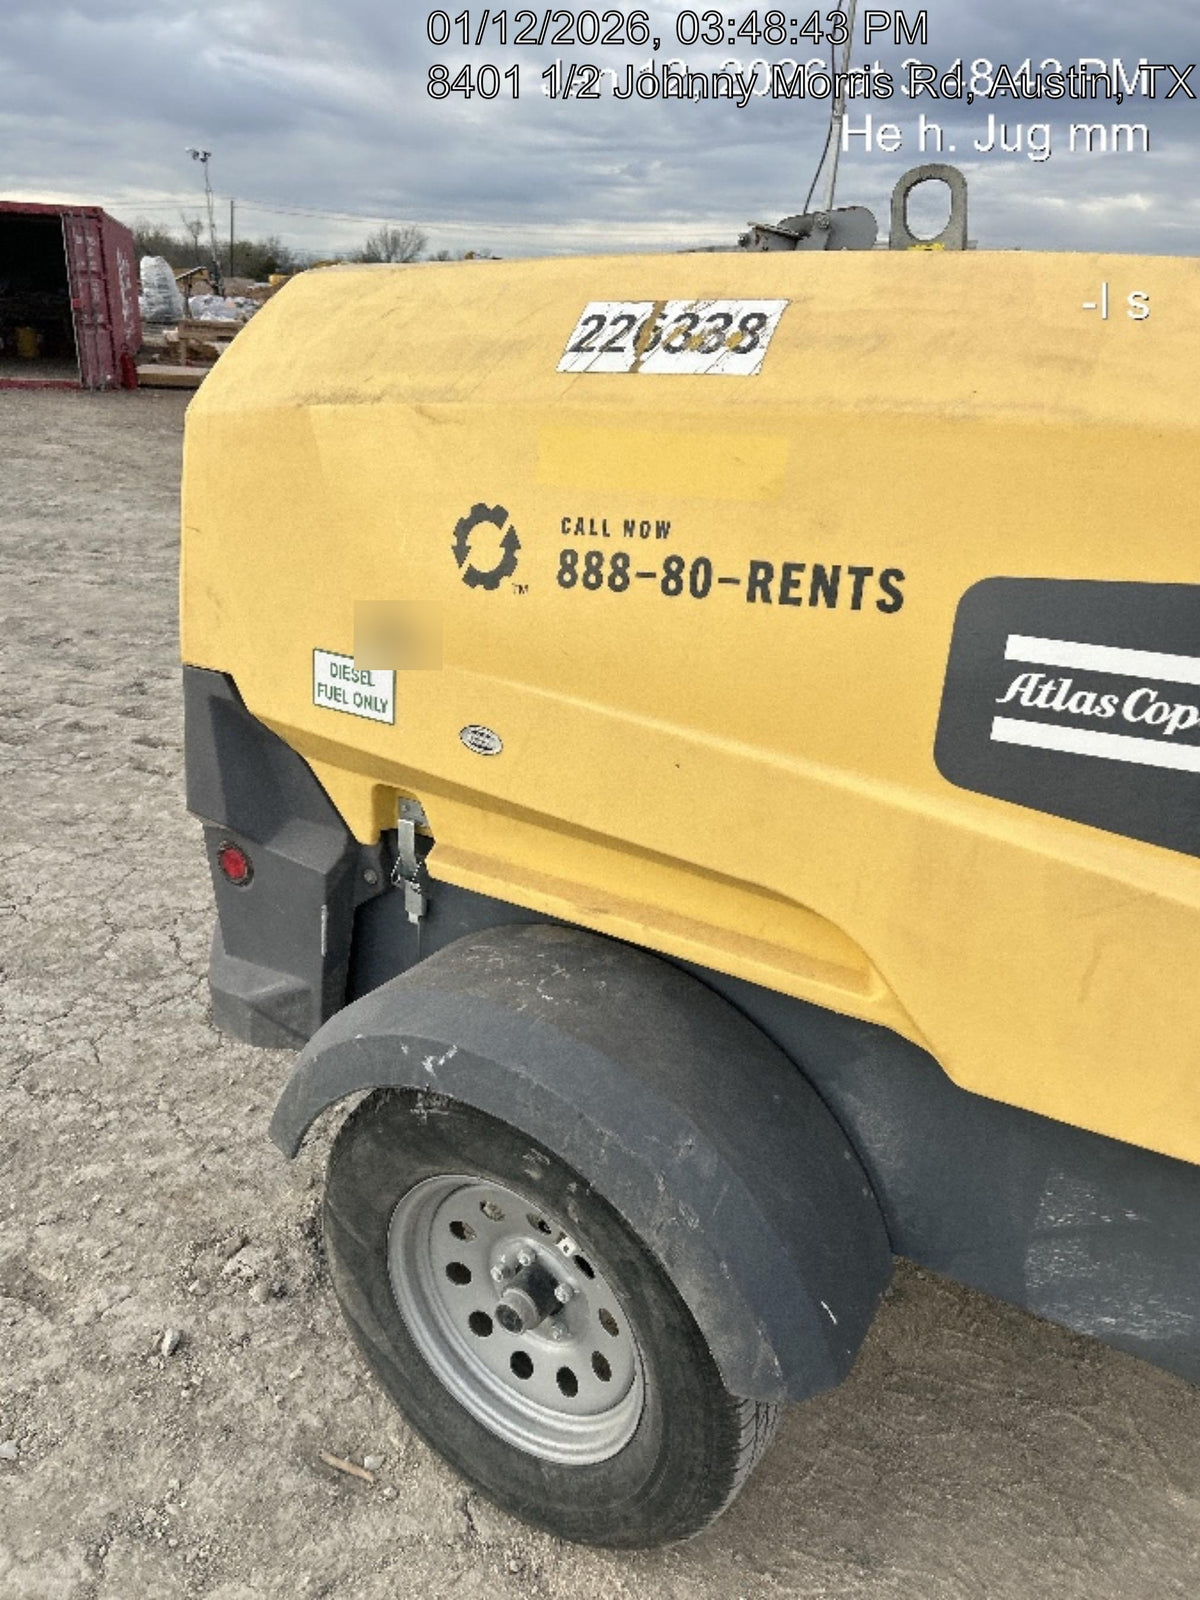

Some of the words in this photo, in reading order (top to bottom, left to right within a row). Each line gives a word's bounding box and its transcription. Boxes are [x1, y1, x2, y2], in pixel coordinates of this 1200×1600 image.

[561, 516, 611, 538] CALL
[623, 519, 672, 540] NOW
[556, 548, 907, 614] 888-80-RENTS
[329, 661, 375, 687] DIESEL
[317, 682, 349, 705] FUEL
[353, 691, 388, 714] ONLY
[995, 673, 1119, 718] Atlas
[1121, 687, 1200, 735] Cop
